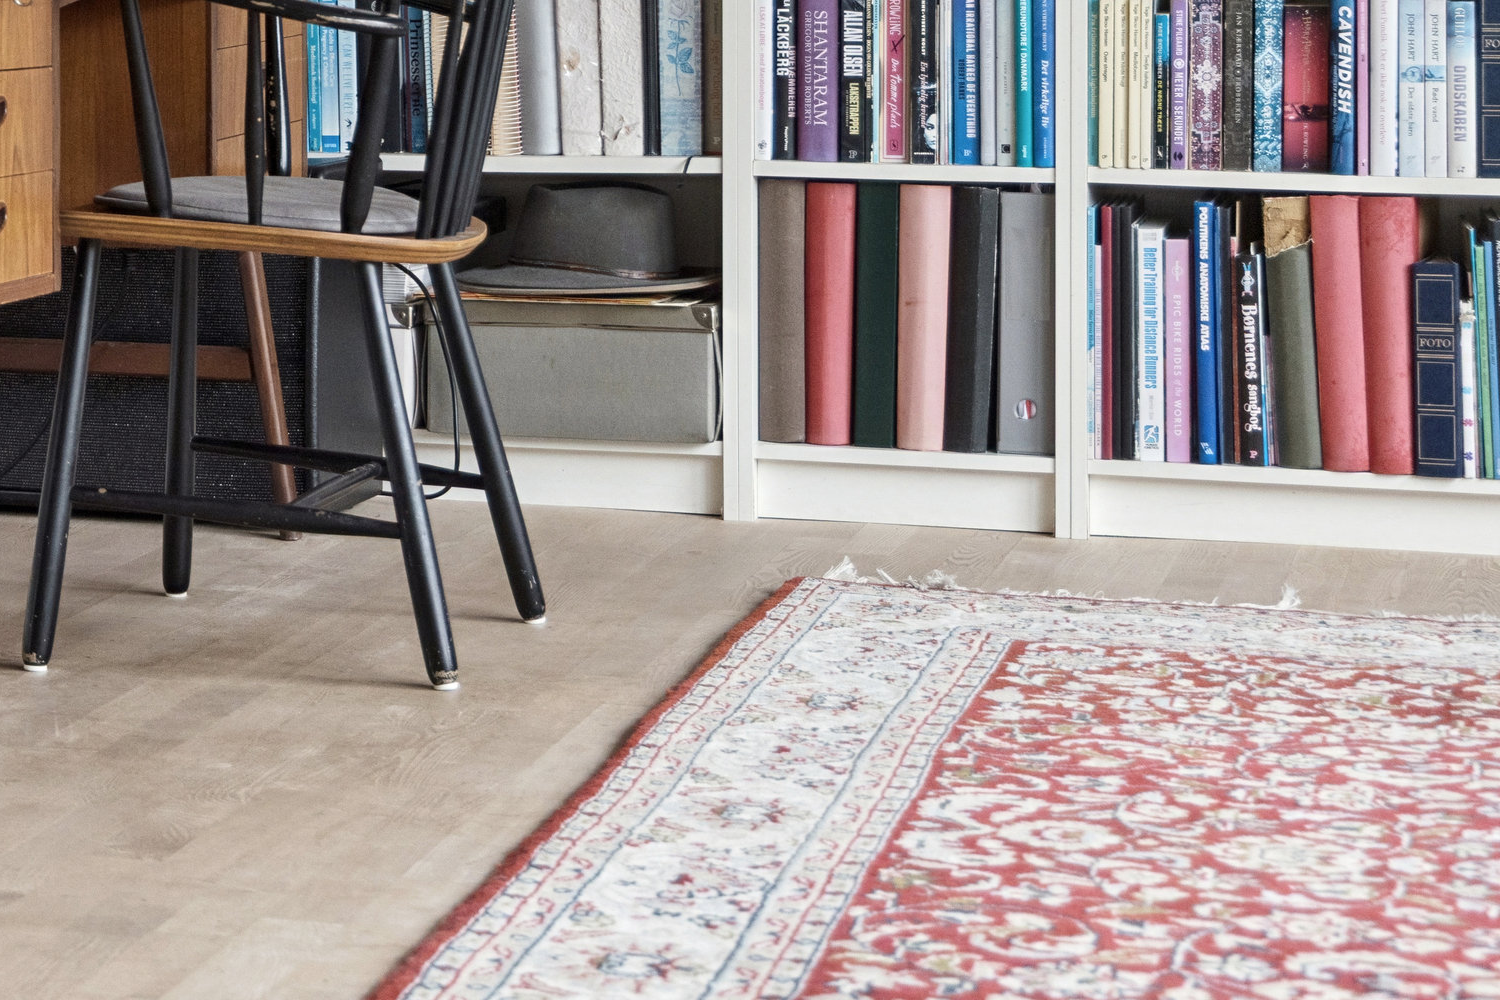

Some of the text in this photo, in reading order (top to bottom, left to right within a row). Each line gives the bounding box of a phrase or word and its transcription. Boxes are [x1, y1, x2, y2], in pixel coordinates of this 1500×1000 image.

[410, 18, 420, 117] Prinsesserne
[814, 10, 828, 126] SHANTARAM
[844, 10, 862, 135] ALLAN OLSEN LAKSETRAPPEN
[1020, 53, 1028, 92] DANMARK
[1337, 6, 1352, 114] CAVENDISH
[1406, 14, 1416, 62] JOHN HART
[1454, 66, 1467, 142] ONDSKABEN
[1143, 248, 1158, 389] Better Training for Distance Runners
[1199, 206, 1210, 351] POLITIKENS ANATOMISKE ATLAS
[1241, 303, 1262, 432] Børnenes sangbog
[1420, 338, 1452, 348] FOTO
